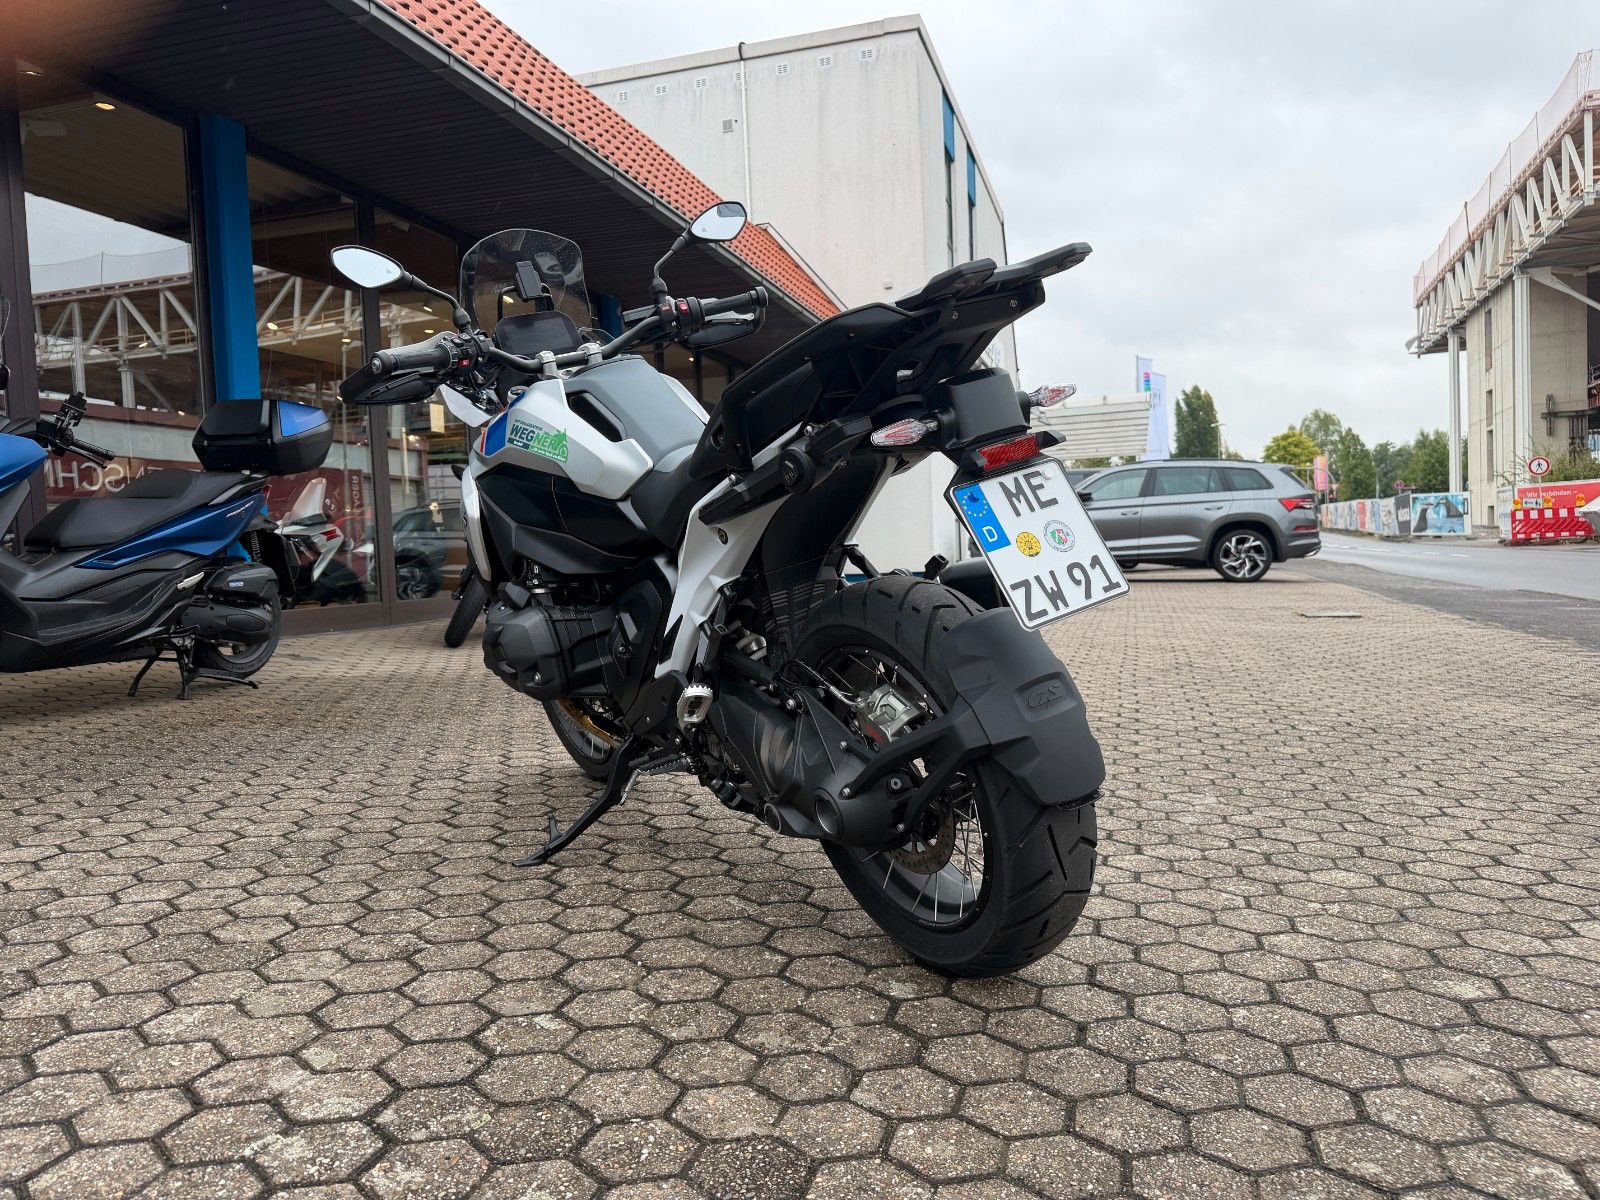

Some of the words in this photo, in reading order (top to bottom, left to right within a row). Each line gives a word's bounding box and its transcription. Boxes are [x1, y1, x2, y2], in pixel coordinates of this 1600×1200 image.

[510, 423, 557, 450] WEGNER
[999, 471, 1059, 517] ME
[982, 526, 998, 542] D
[1010, 569, 1070, 622] ZW
[1066, 554, 1122, 600] 91
